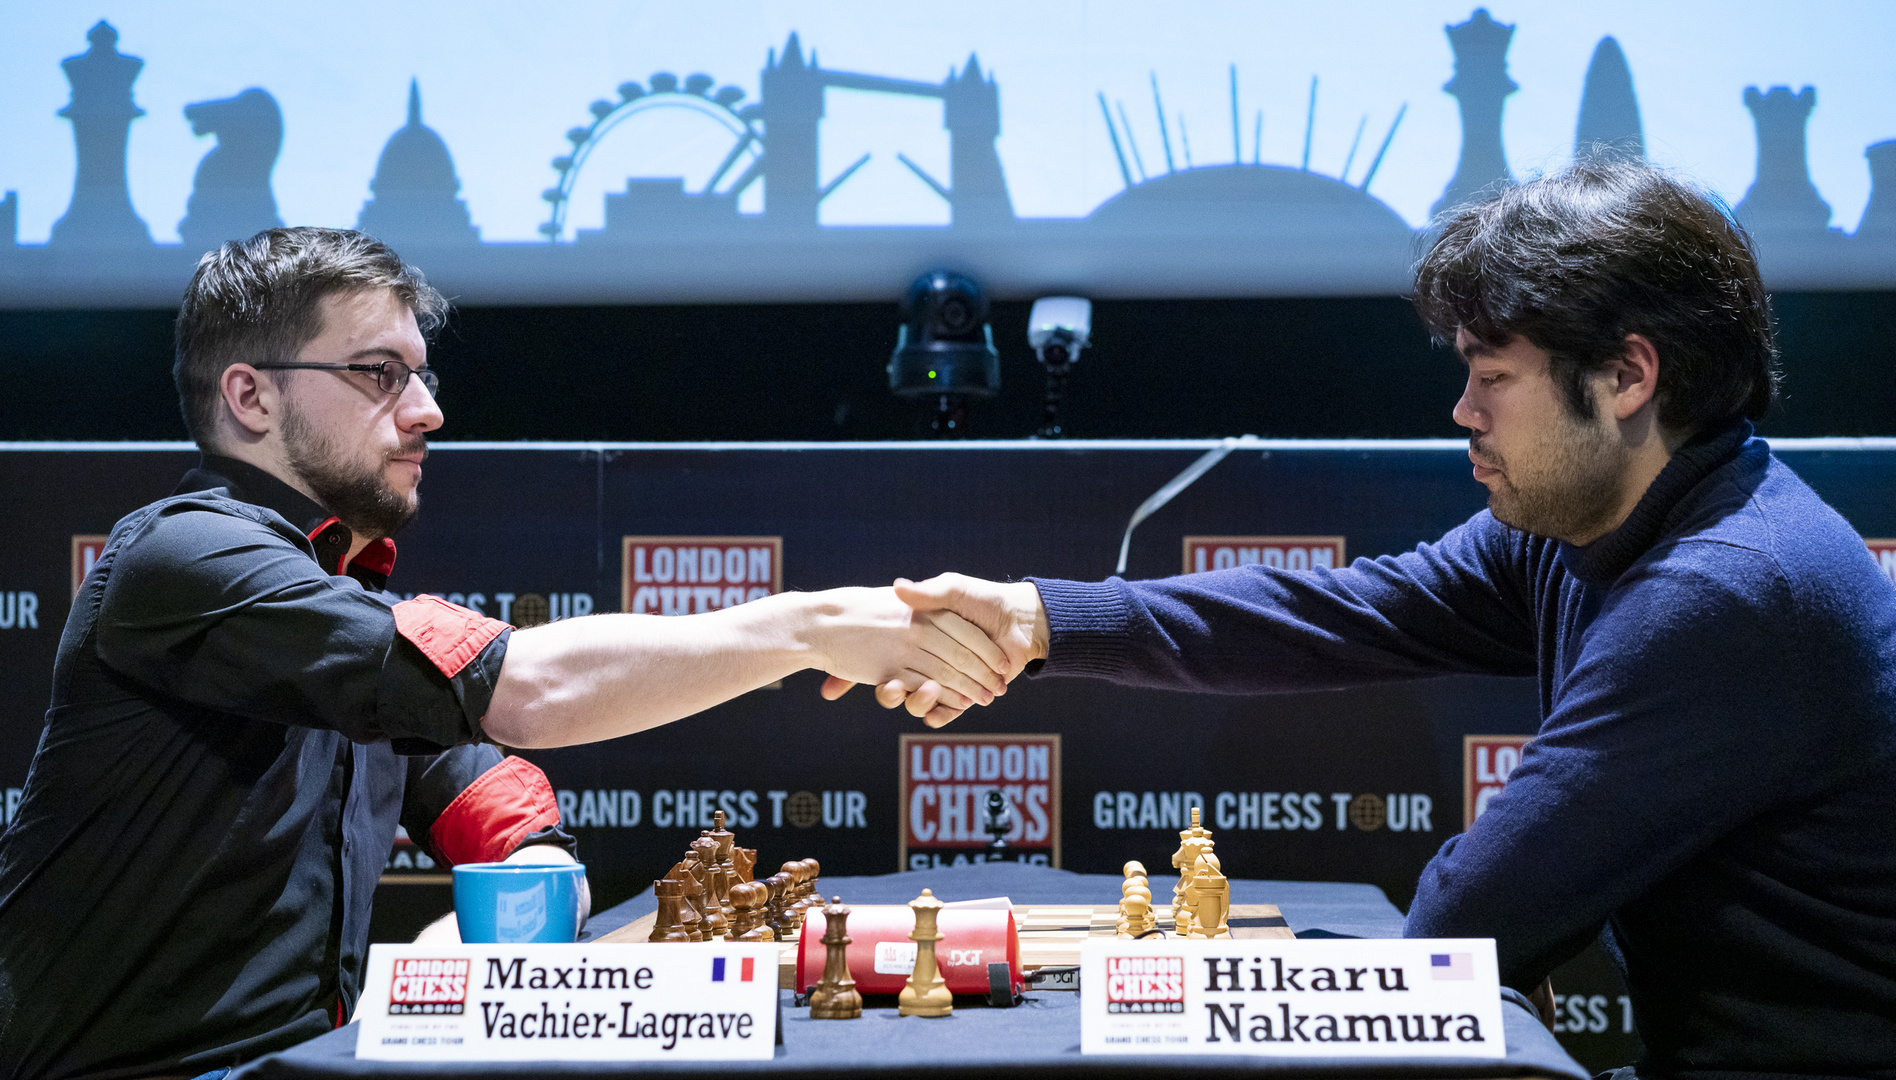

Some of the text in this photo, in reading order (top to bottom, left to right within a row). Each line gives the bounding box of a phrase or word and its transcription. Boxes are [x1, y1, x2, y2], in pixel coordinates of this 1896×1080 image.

[634, 547, 771, 583] LONDON
[0, 591, 39, 629] UR
[912, 746, 1048, 780] LONDON
[556, 790, 642, 828] RAND
[652, 790, 759, 828] CHESS
[1093, 791, 1204, 830] GRAND
[1215, 792, 1323, 831] CHESS
[395, 960, 468, 976] LONDON
[484, 957, 653, 990] Maxime
[951, 950, 983, 966] DGT
[1109, 958, 1182, 974] LONDON
[1203, 958, 1408, 991] Hikaru
[393, 977, 466, 1001] CHESS
[1109, 975, 1183, 1000] CHESS
[390, 1004, 463, 1013] CLASSIC
[1109, 1002, 1182, 1013] CLASSIC
[1205, 1003, 1485, 1043] Nakamura
[1554, 994, 1608, 1033] ESS
[481, 1002, 753, 1050] Vachier-Lagrave
